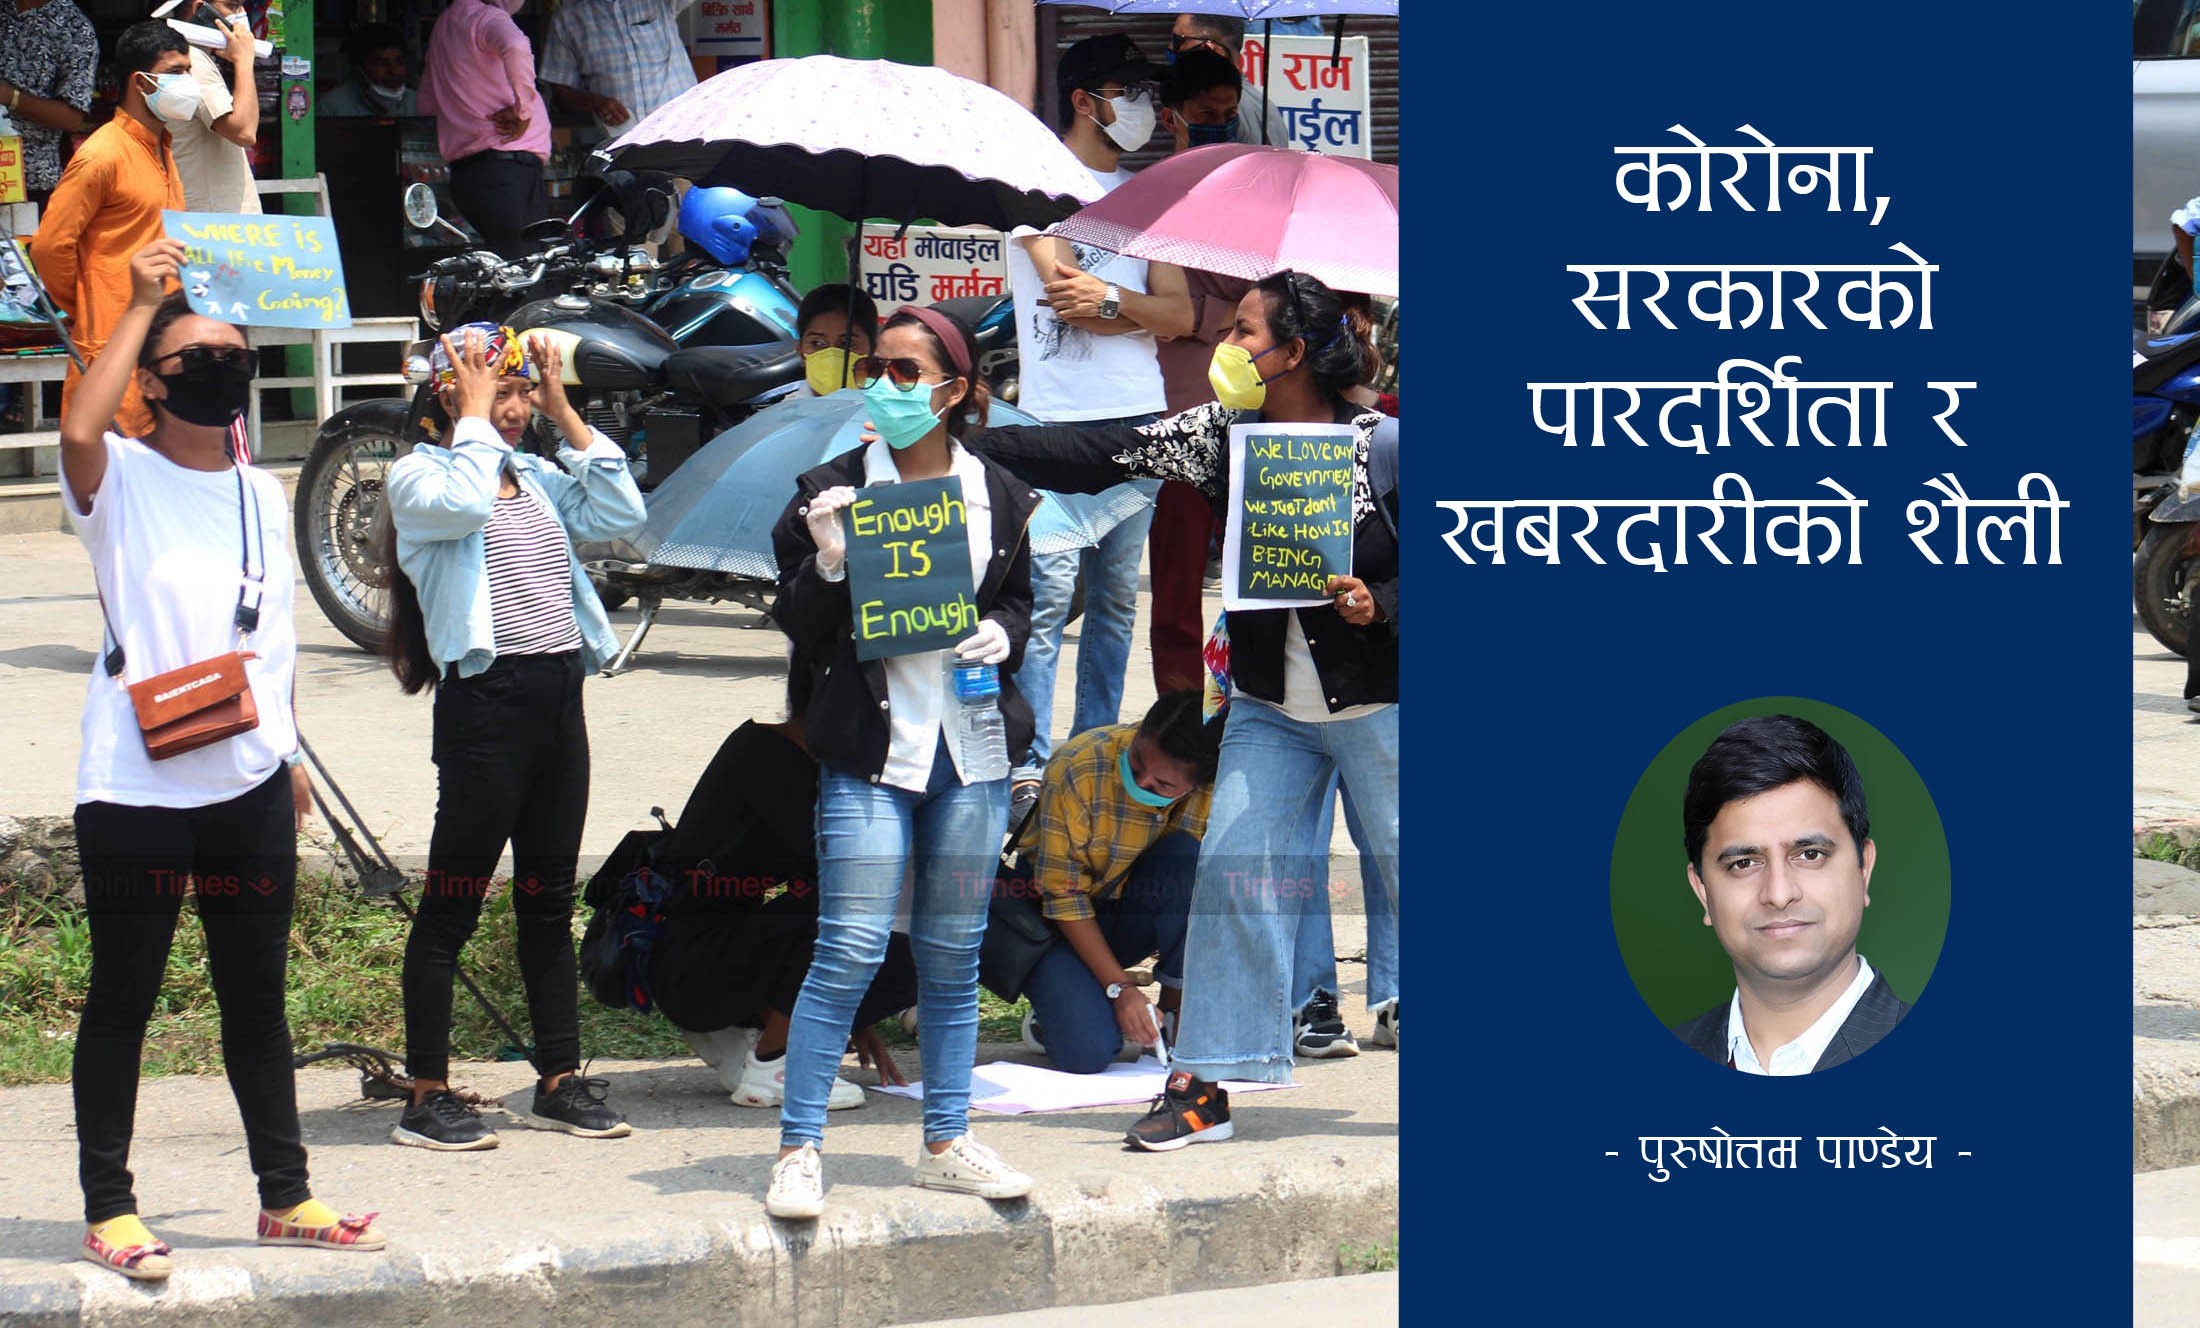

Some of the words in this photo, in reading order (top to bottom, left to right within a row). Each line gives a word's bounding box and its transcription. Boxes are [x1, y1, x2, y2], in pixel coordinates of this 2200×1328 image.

[1281, 53, 1353, 91] राम
[181, 223, 283, 248] WHERE
[865, 263, 921, 302] घडि
[929, 268, 1004, 302] मर्मत
[1251, 438, 1283, 460] We
[851, 490, 966, 537] Enough
[882, 538, 932, 579] IS
[1252, 545, 1323, 569] BEING
[860, 592, 980, 640] Enough
